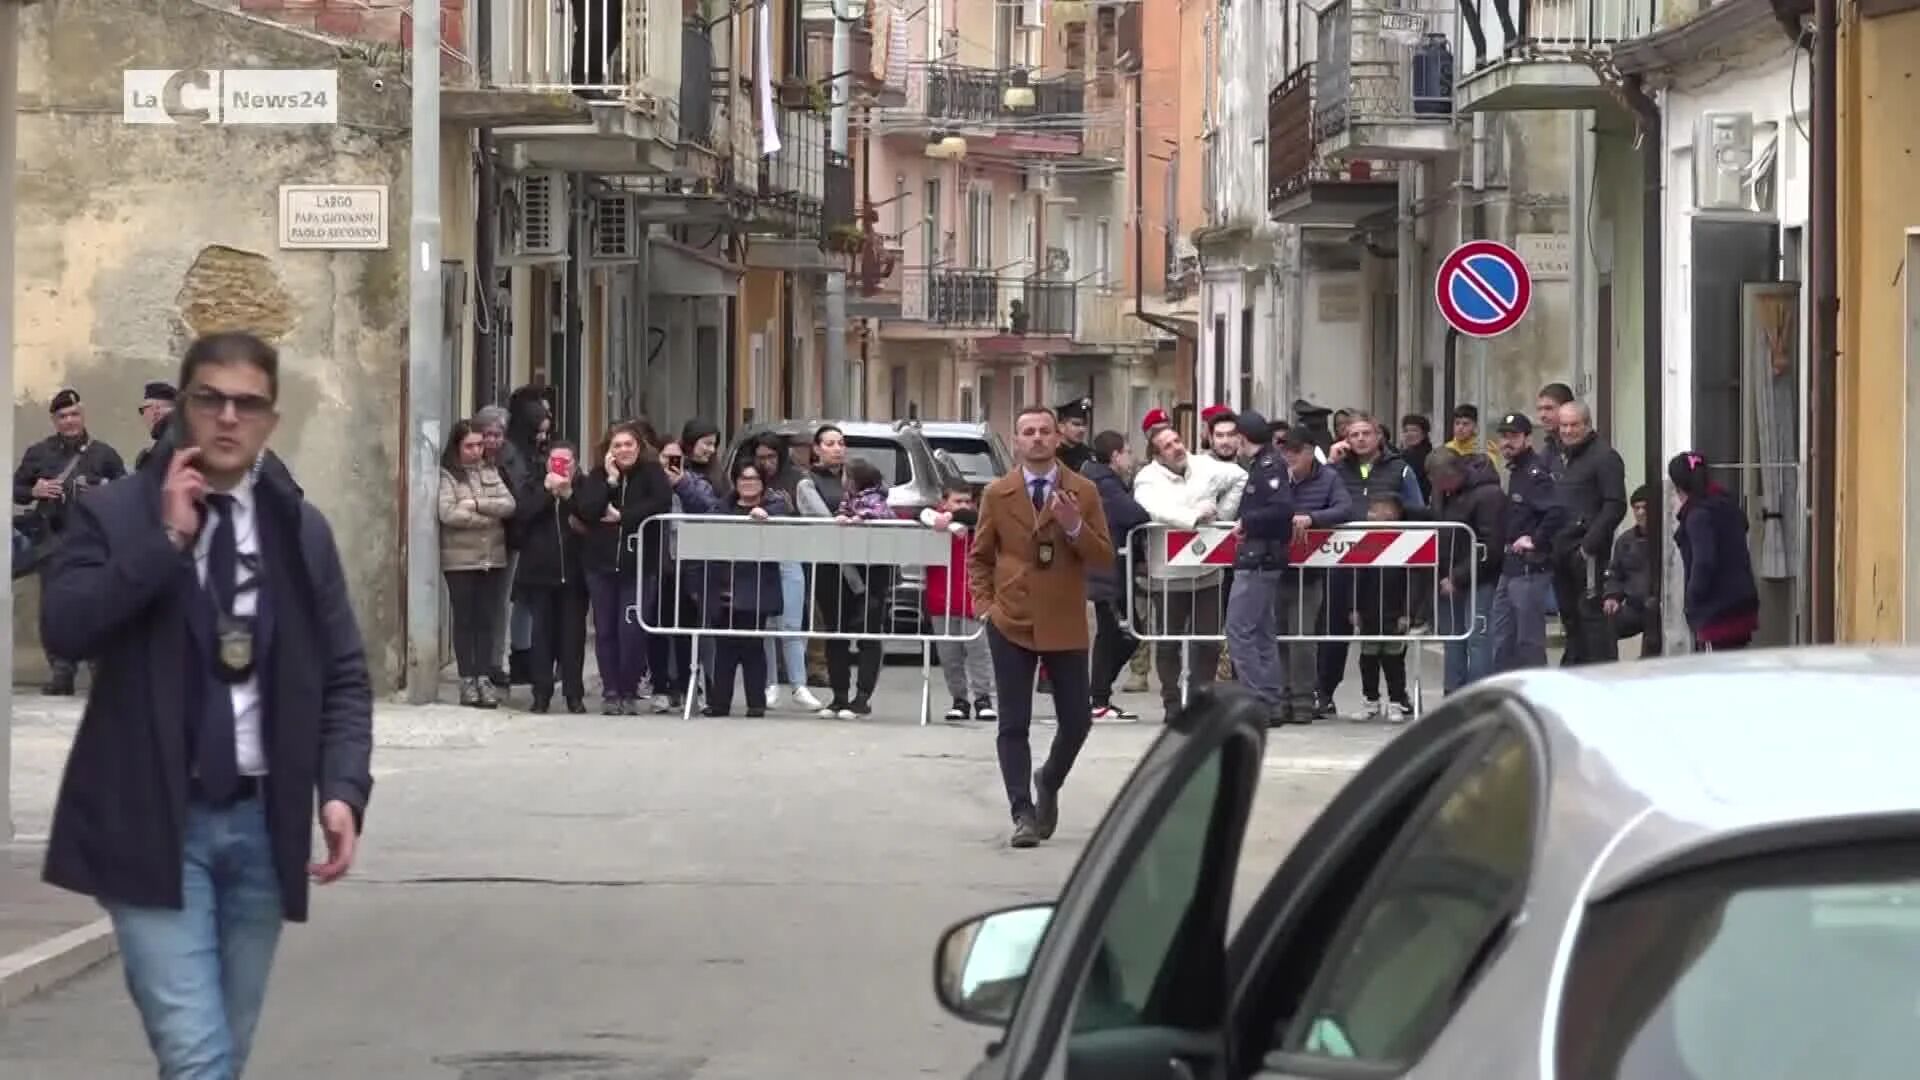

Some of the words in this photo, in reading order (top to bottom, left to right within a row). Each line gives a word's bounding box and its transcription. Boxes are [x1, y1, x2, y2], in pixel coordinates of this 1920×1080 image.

[316, 195, 353, 208] LARGO
[295, 212, 320, 224] PAPA
[321, 212, 374, 224] GIOVANNI
[291, 227, 325, 239] PAOLO
